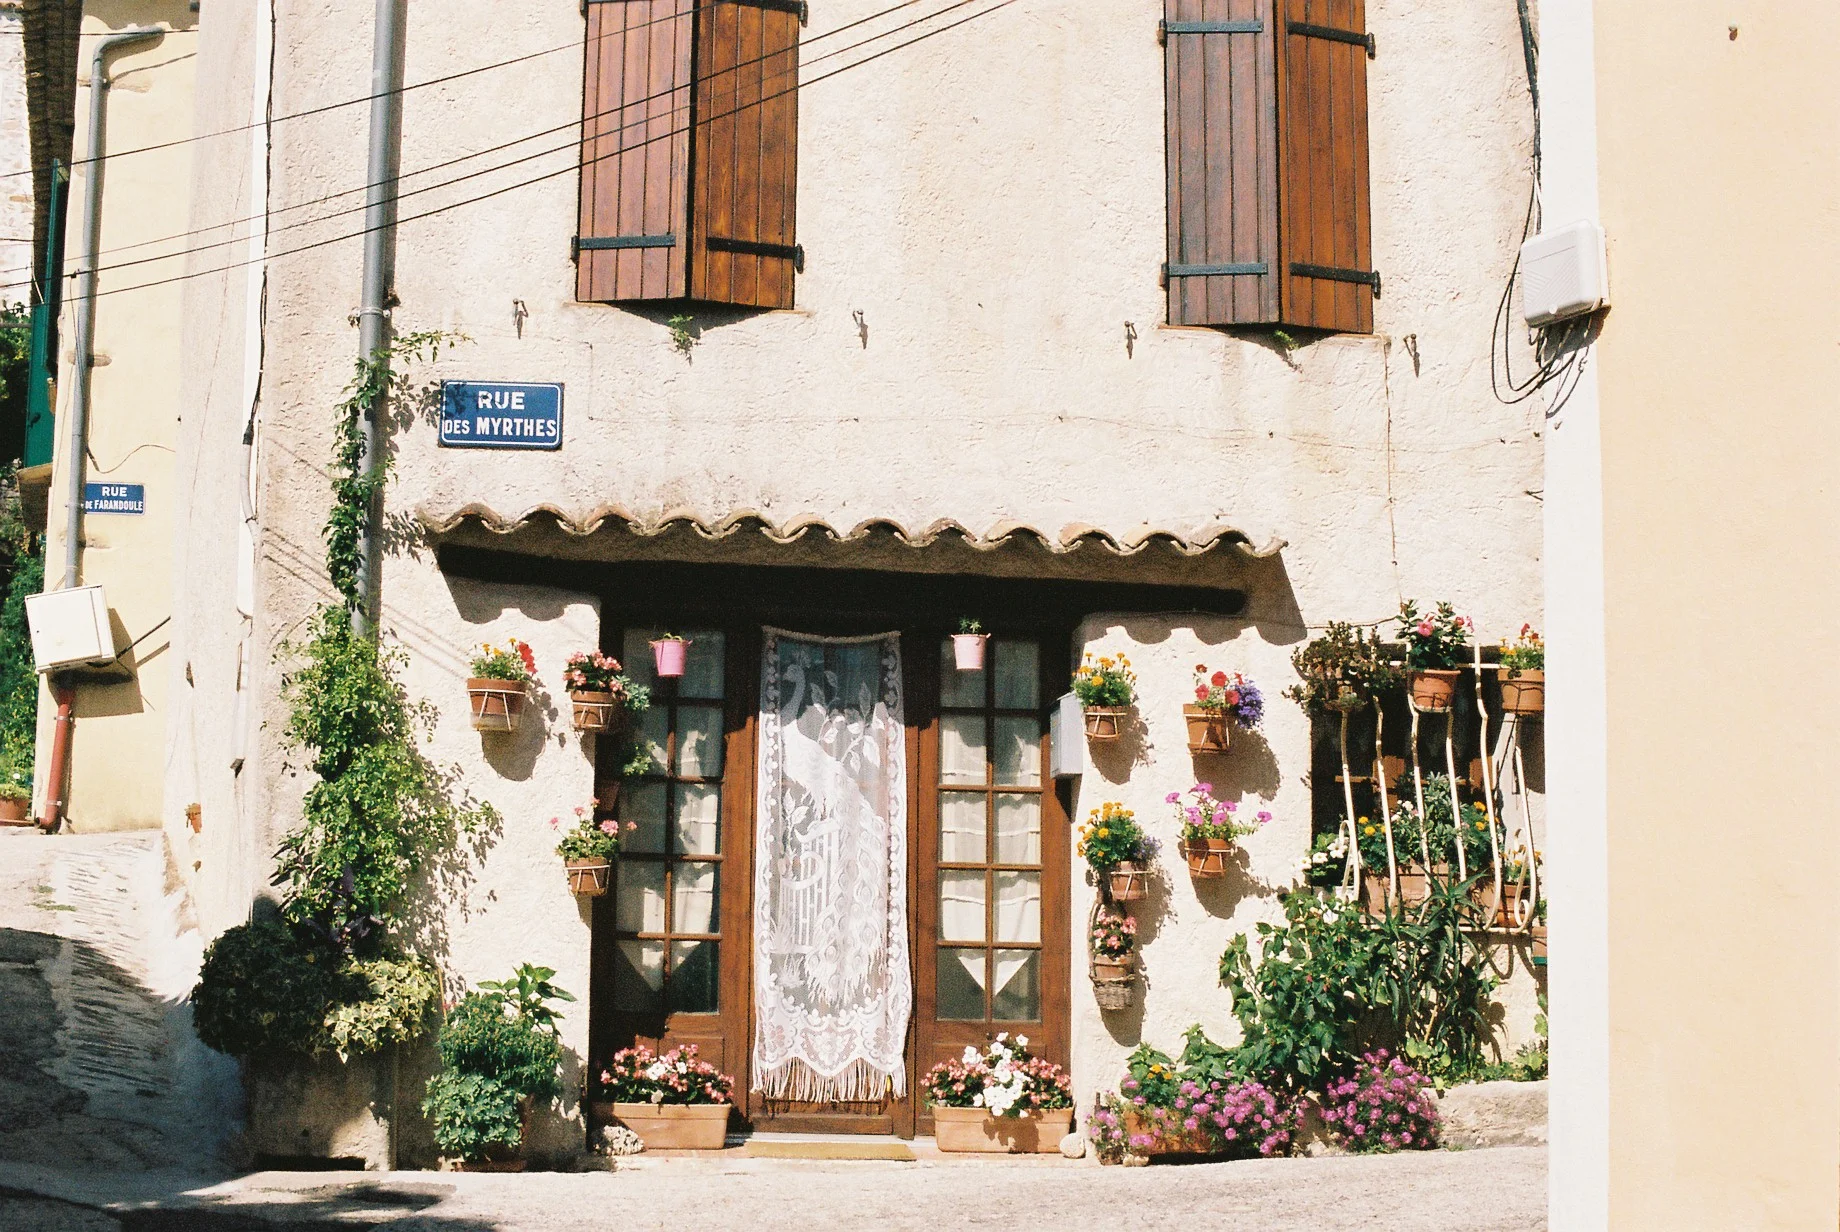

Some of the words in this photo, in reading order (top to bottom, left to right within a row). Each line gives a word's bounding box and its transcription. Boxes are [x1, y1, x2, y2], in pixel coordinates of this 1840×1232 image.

[478, 391, 525, 410] RUE
[444, 419, 470, 435] DES
[476, 416, 557, 437] MYRTHES
[102, 486, 128, 497] RUE
[94, 499, 144, 511] FARANDOULE
